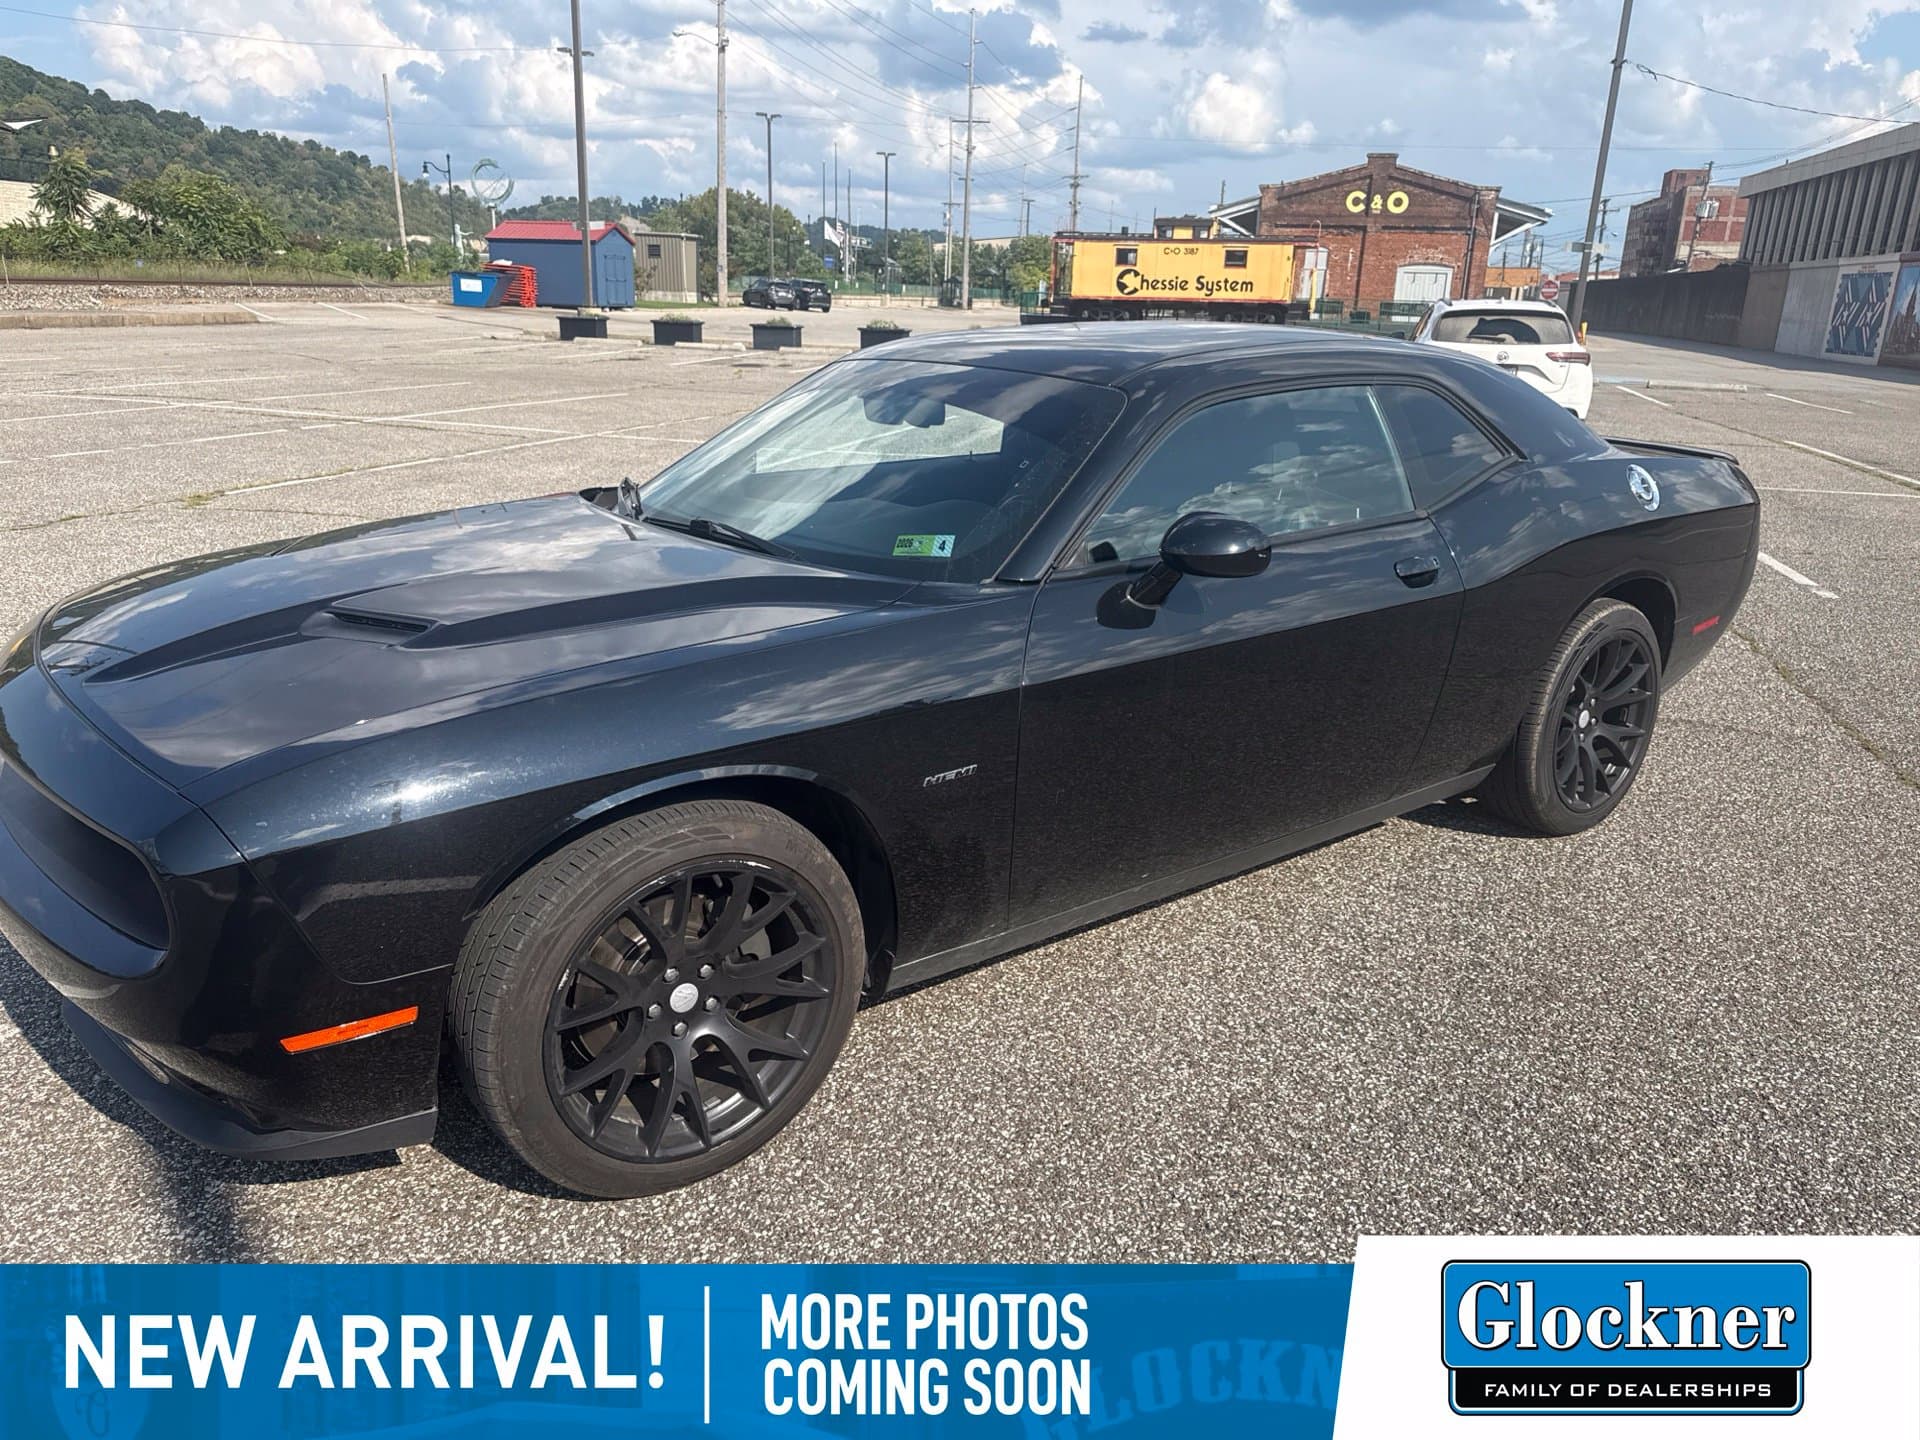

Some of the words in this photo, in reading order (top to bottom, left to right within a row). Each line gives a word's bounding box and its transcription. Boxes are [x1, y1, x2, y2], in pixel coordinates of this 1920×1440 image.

[1116, 268, 1189, 296] Chessie
[1195, 275, 1254, 297] System
[938, 540, 946, 552] 4
